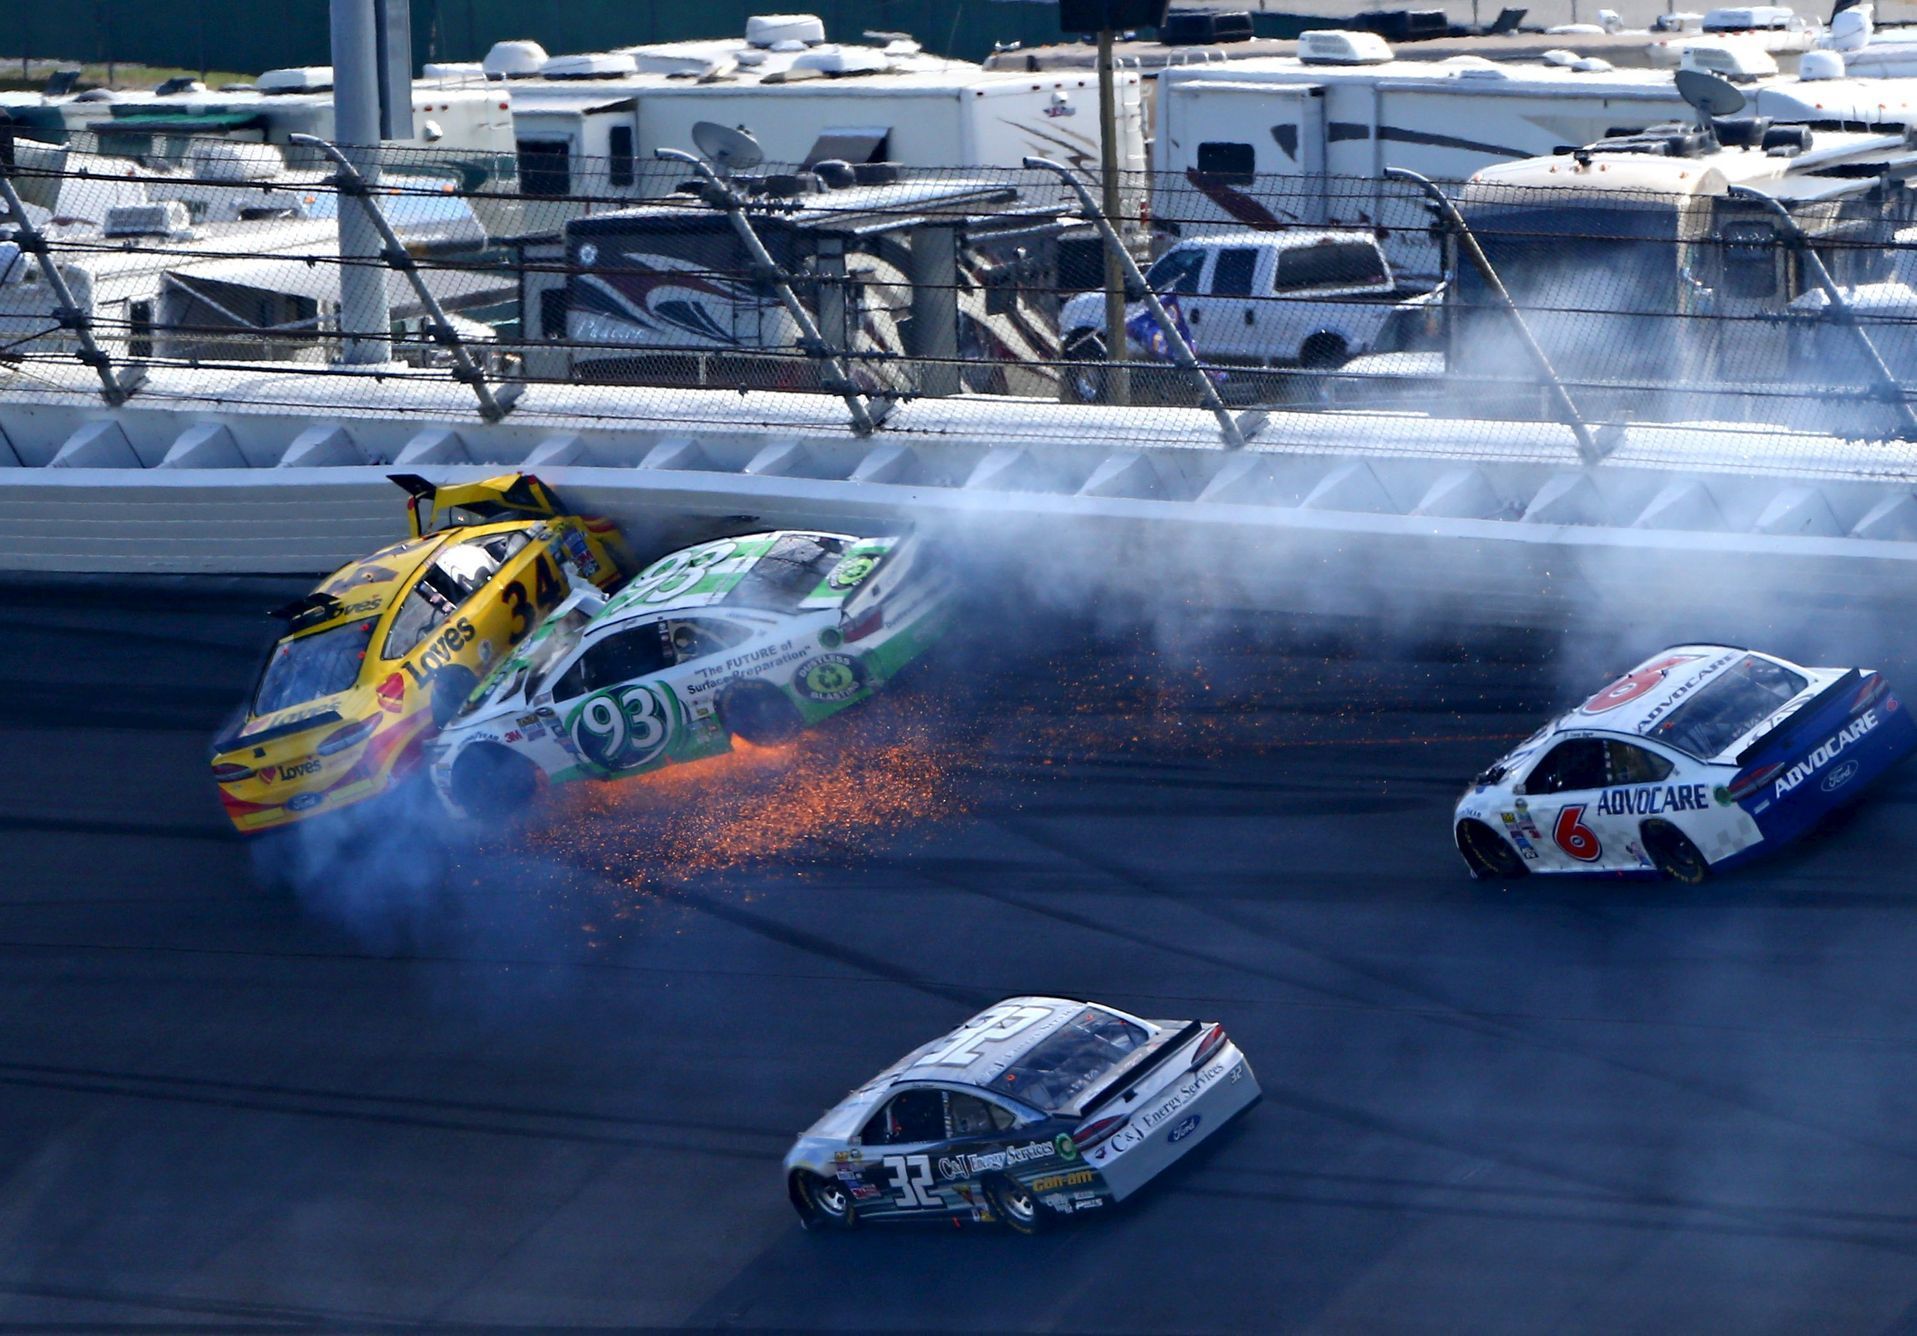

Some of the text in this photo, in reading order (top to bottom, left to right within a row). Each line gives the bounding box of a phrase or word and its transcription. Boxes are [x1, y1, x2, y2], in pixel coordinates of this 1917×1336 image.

[502, 553, 564, 645] 34
[726, 644, 777, 670] FUTURE
[780, 640, 793, 652] of
[798, 654, 851, 679] DUSTLESS
[1636, 652, 1740, 734] ADVOCARE
[504, 729, 523, 743] 3M
[582, 687, 664, 757] 93
[1774, 708, 1879, 799] ADVOCARE
[1827, 762, 1853, 788] Ford
[1597, 784, 1709, 816] ADVOCARE
[1552, 803, 1603, 863] 6
[1111, 1063, 1224, 1152] C&J Energy Services
[1172, 1117, 1196, 1141] Ford
[883, 1154, 944, 1208] 32
[939, 1141, 1056, 1180] C&J Energy Services
